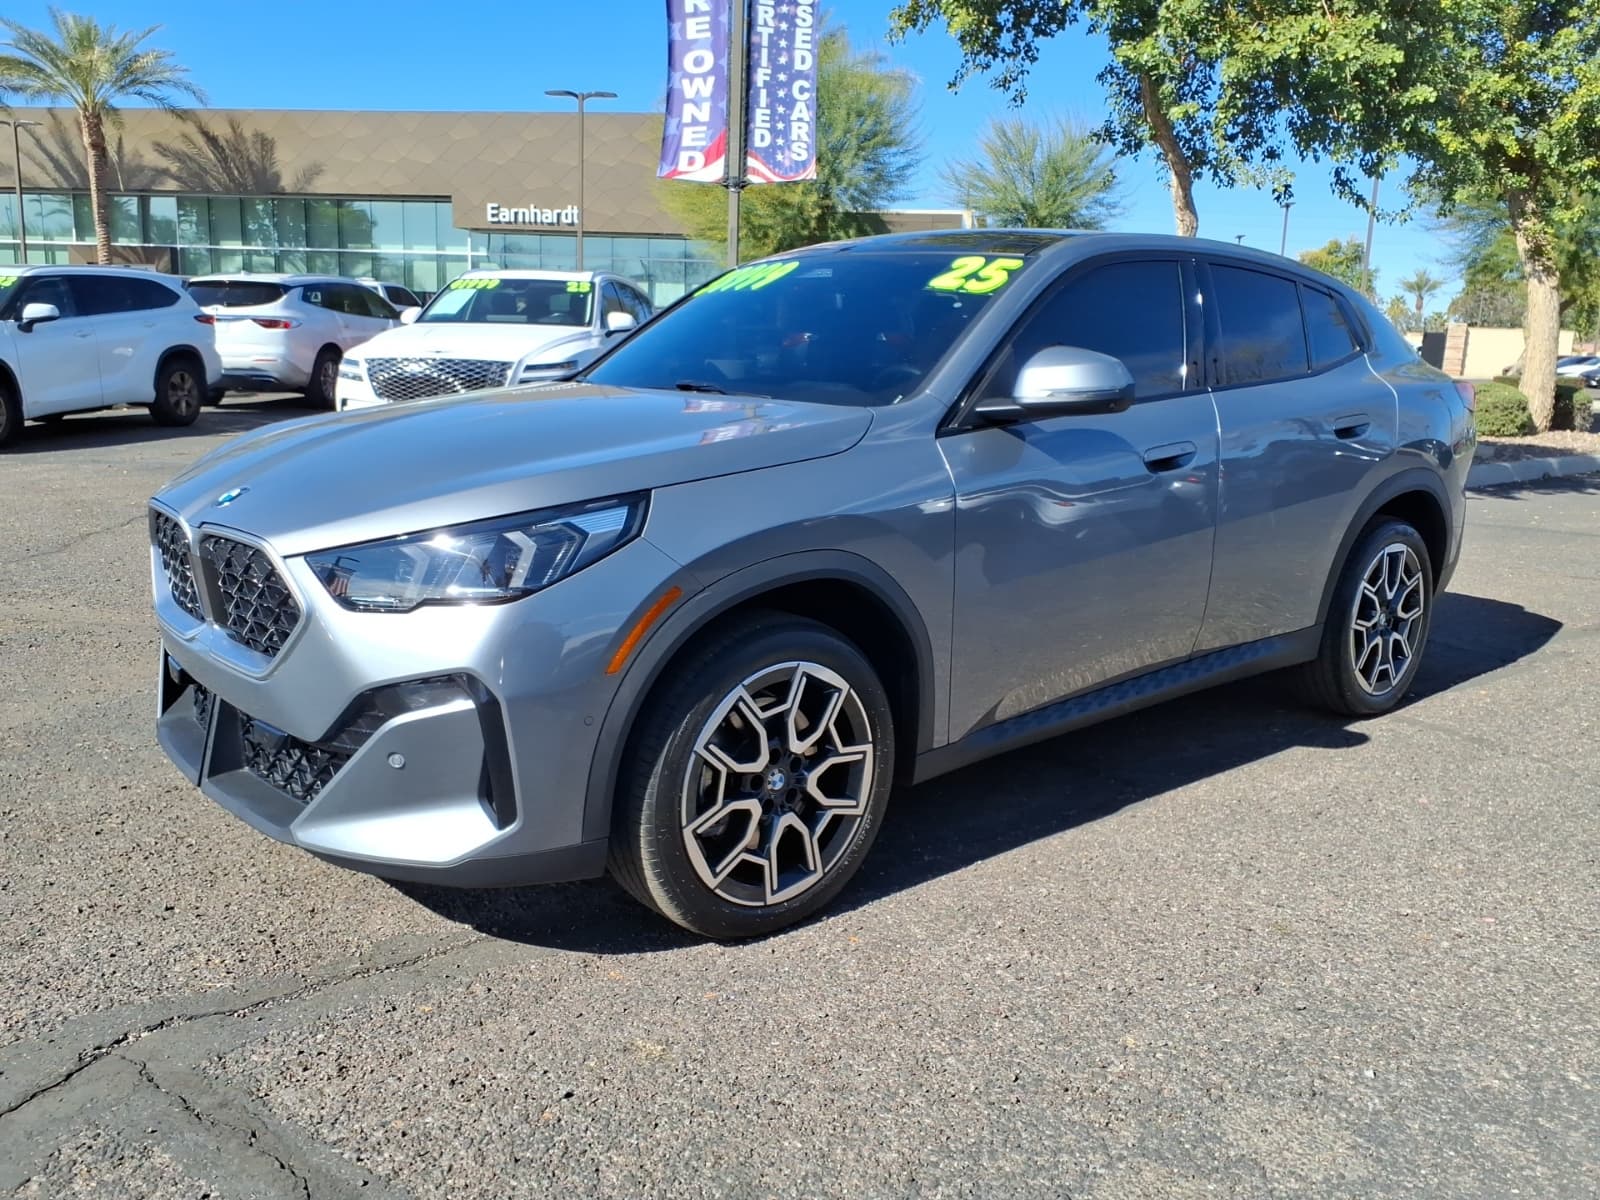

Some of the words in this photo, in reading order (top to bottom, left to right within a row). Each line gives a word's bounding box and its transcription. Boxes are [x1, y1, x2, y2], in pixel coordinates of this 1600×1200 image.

[753, 0, 775, 148] RTIFIED
[793, 0, 814, 71] SED
[678, 49, 715, 172] OWNED
[790, 79, 811, 162] CARS
[486, 202, 580, 224] Earnhardt
[928, 256, 1025, 294] 25
